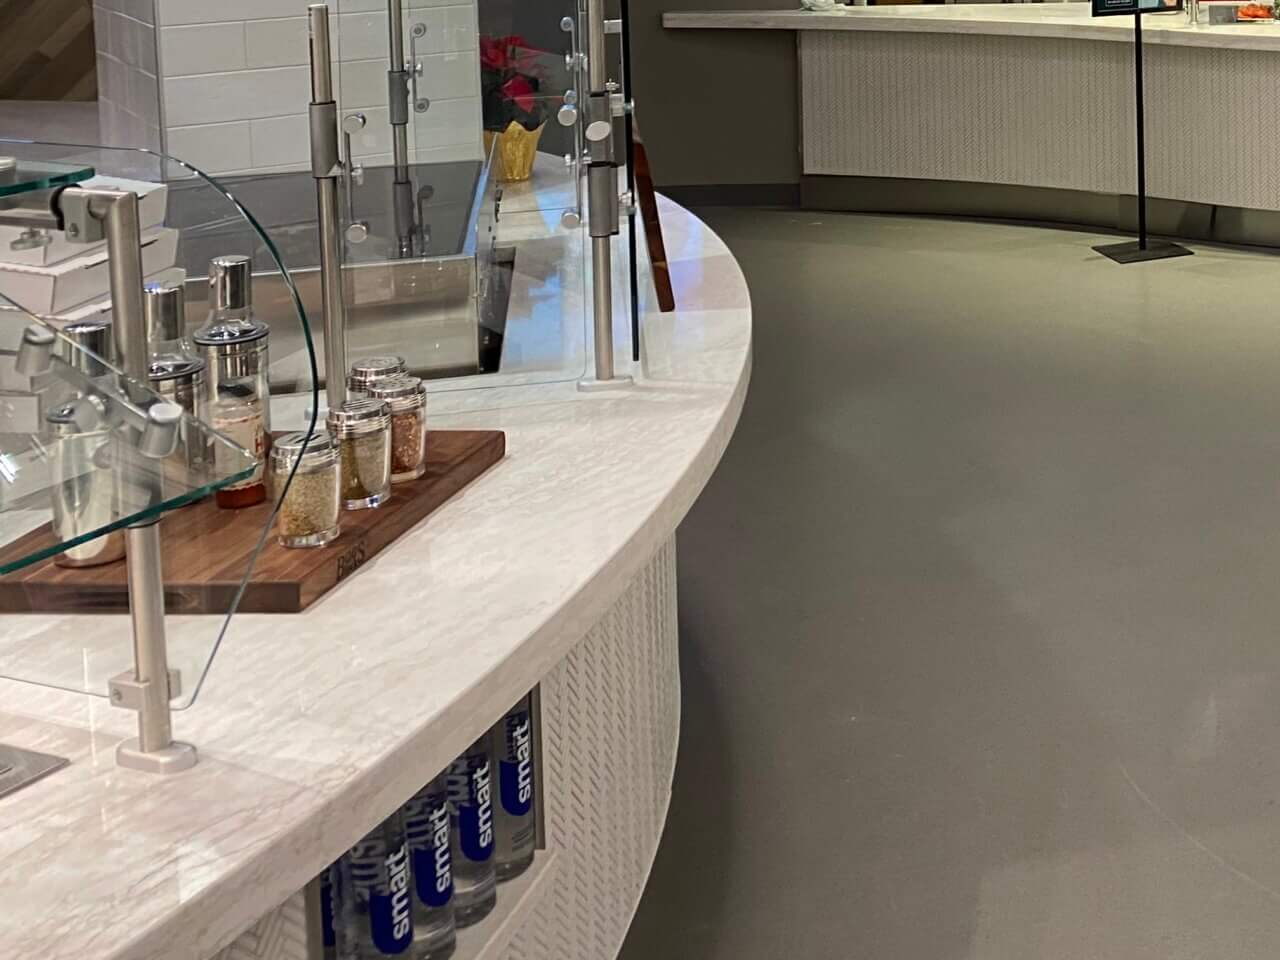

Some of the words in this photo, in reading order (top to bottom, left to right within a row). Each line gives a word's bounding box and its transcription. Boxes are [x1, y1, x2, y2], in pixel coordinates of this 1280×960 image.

[472, 760, 493, 849] smart
[512, 719, 531, 804] smart
[384, 842, 410, 941] smart
[429, 799, 451, 893] smart
